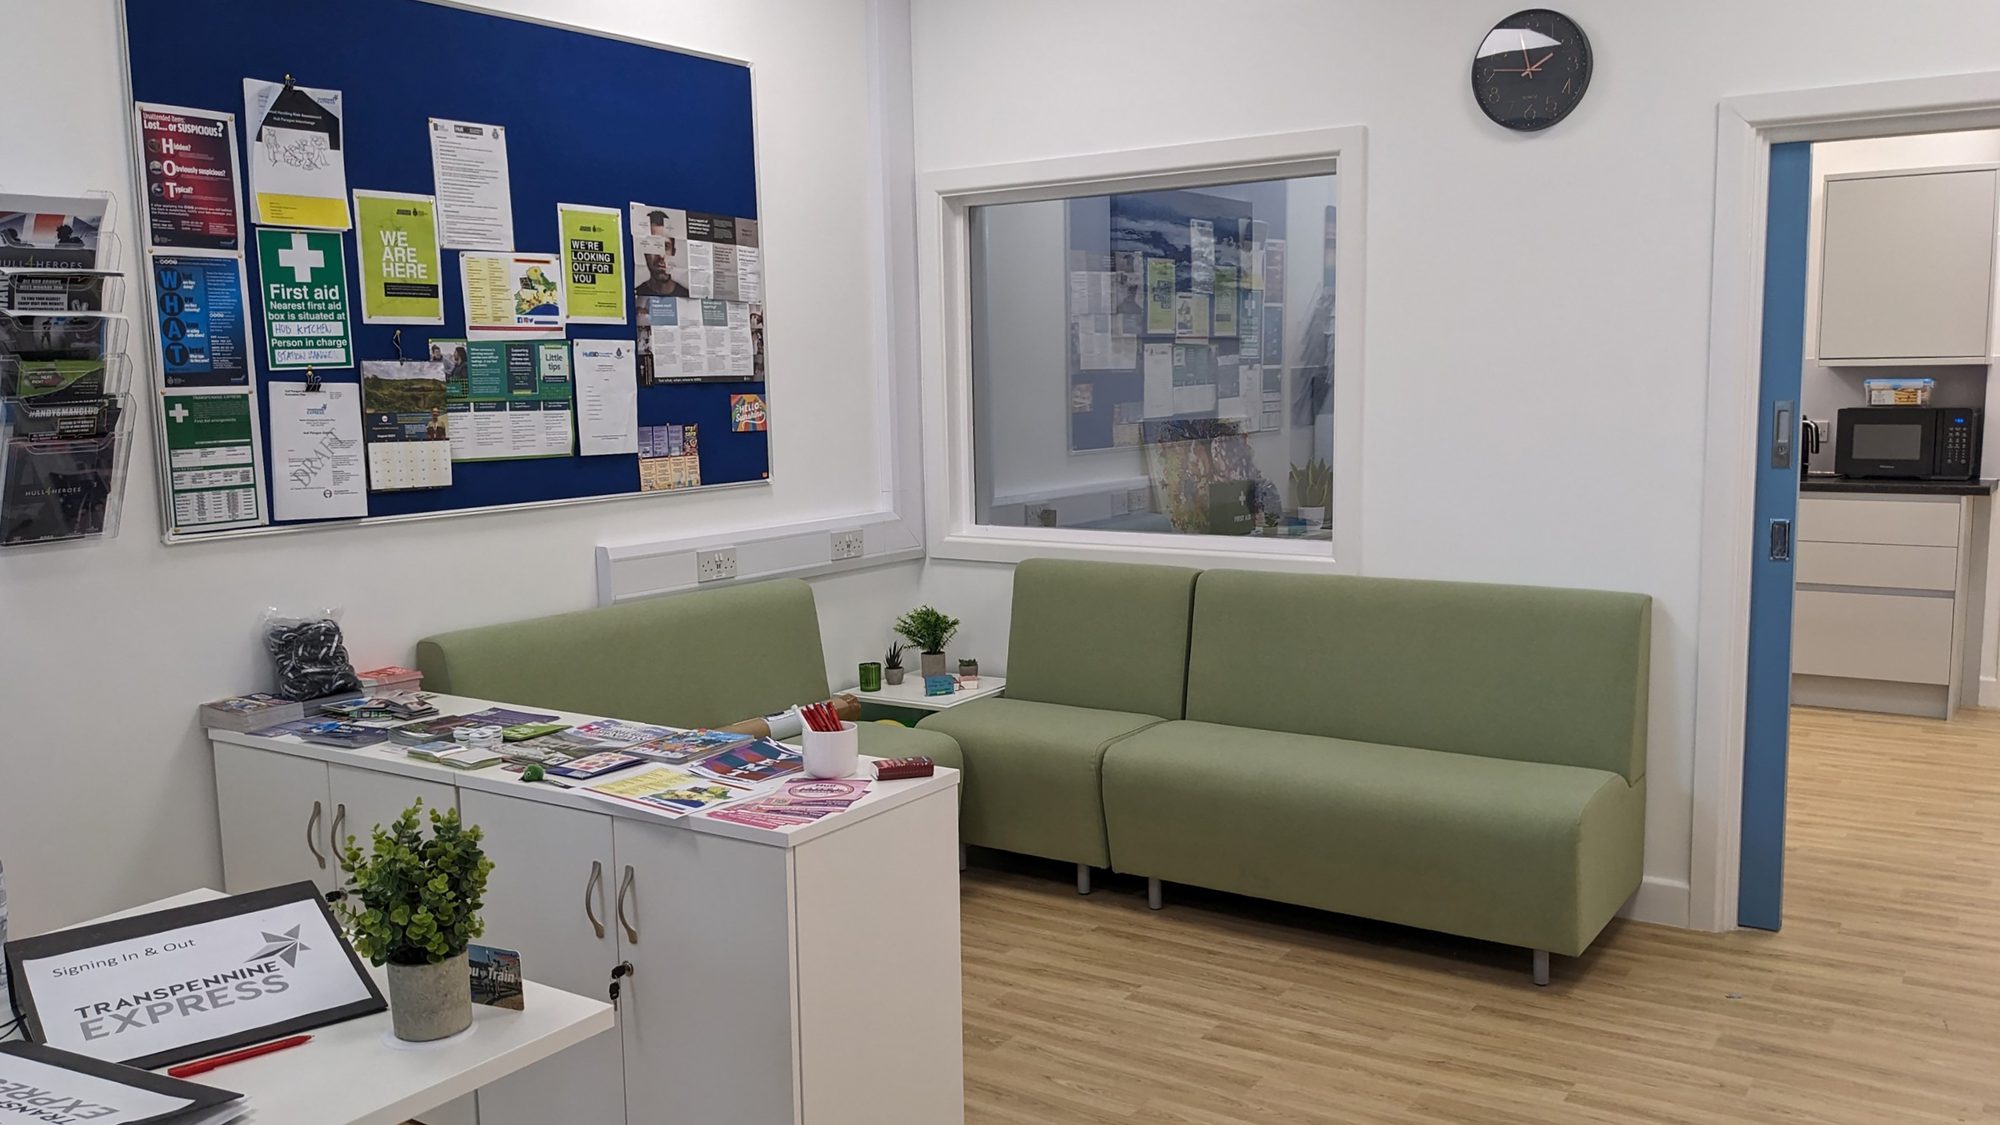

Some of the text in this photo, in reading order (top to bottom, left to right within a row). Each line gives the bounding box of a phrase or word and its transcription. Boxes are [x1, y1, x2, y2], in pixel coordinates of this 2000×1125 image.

[1488, 87, 1500, 104] 8
[1523, 103, 1537, 120] 6
[168, 123, 176, 131] or
[177, 121, 224, 137] SUSPICIOUS?
[380, 230, 409, 247] WE
[571, 240, 600, 251] WE'RE
[382, 246, 418, 263] ARE
[572, 251, 611, 263] LOOKING
[382, 262, 428, 279] HERE
[573, 262, 610, 273] OUT FOR
[573, 274, 593, 284] YOU
[270, 284, 340, 300] First aid
[270, 301, 342, 310] Nearest first aid
[268, 312, 346, 320] box is situated at
[271, 338, 348, 348] Person in charge
[545, 354, 563, 362] Little
[548, 363, 561, 372] tips
[739, 402, 760, 413] HELLO
[293, 427, 345, 488] DRAFT
[25, 486, 82, 496] HULL4HEROES
[51, 938, 197, 978] Signing In & Out
[488, 967, 515, 983] Train
[74, 960, 281, 1019] TRANSPENNINE
[79, 974, 291, 1042] EXPRESS
[0, 1079, 121, 1119] EXPRE
